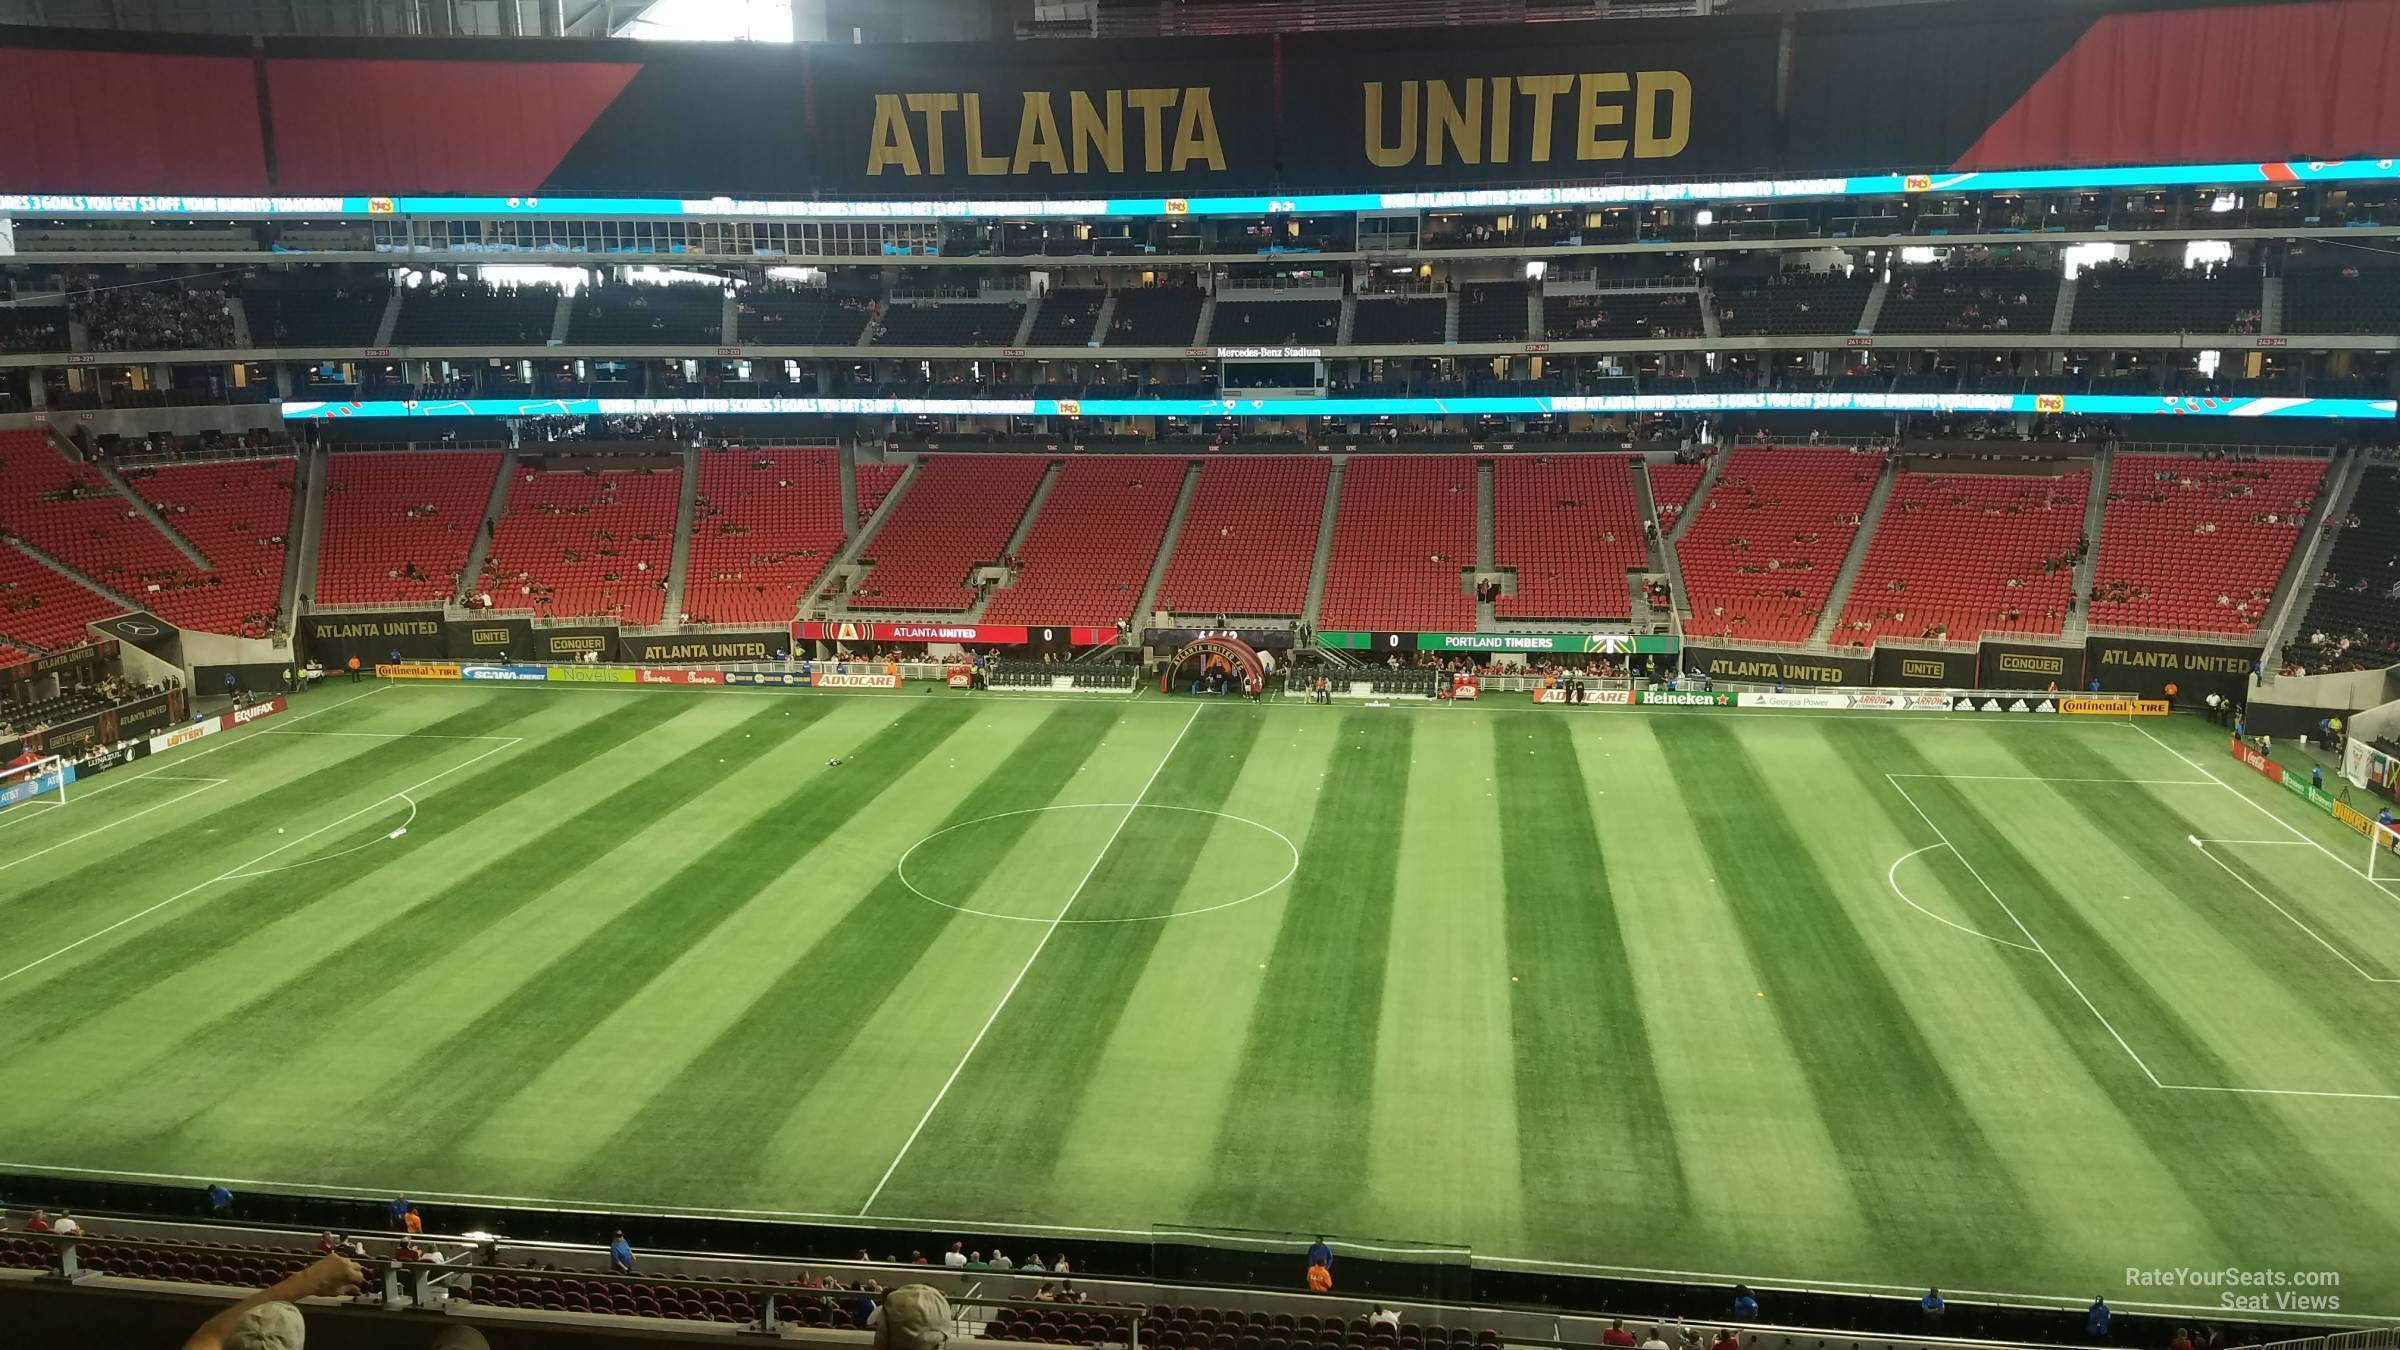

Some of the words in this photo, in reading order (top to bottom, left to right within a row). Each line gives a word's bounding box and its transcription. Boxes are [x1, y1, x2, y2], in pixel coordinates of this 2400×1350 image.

[866, 86, 1228, 176] ATLANTA
[1364, 70, 1693, 168] UNITED
[1217, 347, 1282, 357] Mercedes-Benz
[1284, 347, 1321, 357] Stadium
[316, 623, 379, 638] ATLANTA
[383, 621, 438, 636] UNITED
[893, 628, 937, 637] ATLANTA
[939, 628, 976, 638] UNITED
[1044, 628, 1053, 641] 0
[476, 631, 507, 642] UNITE
[1389, 635, 1399, 648] 0
[1445, 636, 1502, 647] PORTLAND
[1504, 637, 1553, 648] TIMBERS
[554, 639, 602, 651] CONQUER
[644, 644, 706, 660] ATLANTA
[712, 642, 766, 657] UNITED
[37, 655, 68, 671] ATLANTA
[68, 648, 94, 663] UNITED
[1173, 645, 1203, 666] ATLANTA
[1207, 644, 1235, 659] UNITED
[1235, 658, 1244, 671] FC
[2003, 657, 2060, 671] CONQUER
[2101, 649, 2178, 669] ATLANTA
[2184, 655, 2250, 675] UNITED
[379, 665, 429, 677] Continental
[439, 668, 458, 676] TIRE
[473, 670, 516, 680] SCANA
[564, 669, 619, 681] Novelis
[1709, 659, 1778, 679] ATLANTA
[1783, 664, 1843, 684] UNITED
[1906, 663, 1941, 675] UNITE
[820, 675, 895, 687] ADVOCARE
[1543, 690, 1628, 703] ADCARE
[1643, 691, 1714, 705] Heineken
[1769, 697, 1801, 707] Georgia
[1803, 697, 1829, 706] Power
[1858, 695, 1888, 704] ARROW
[1914, 696, 1944, 705] ARROW
[234, 701, 274, 723] EQUIFAX
[2063, 700, 2127, 712] Continental
[2140, 704, 2165, 712] TIRE
[120, 709, 144, 727] ATLANTA
[146, 704, 167, 718] UNITED
[167, 726, 205, 747] LOTTERY
[88, 750, 122, 767] LUNAZUL
[1, 788, 20, 802] AT&T
